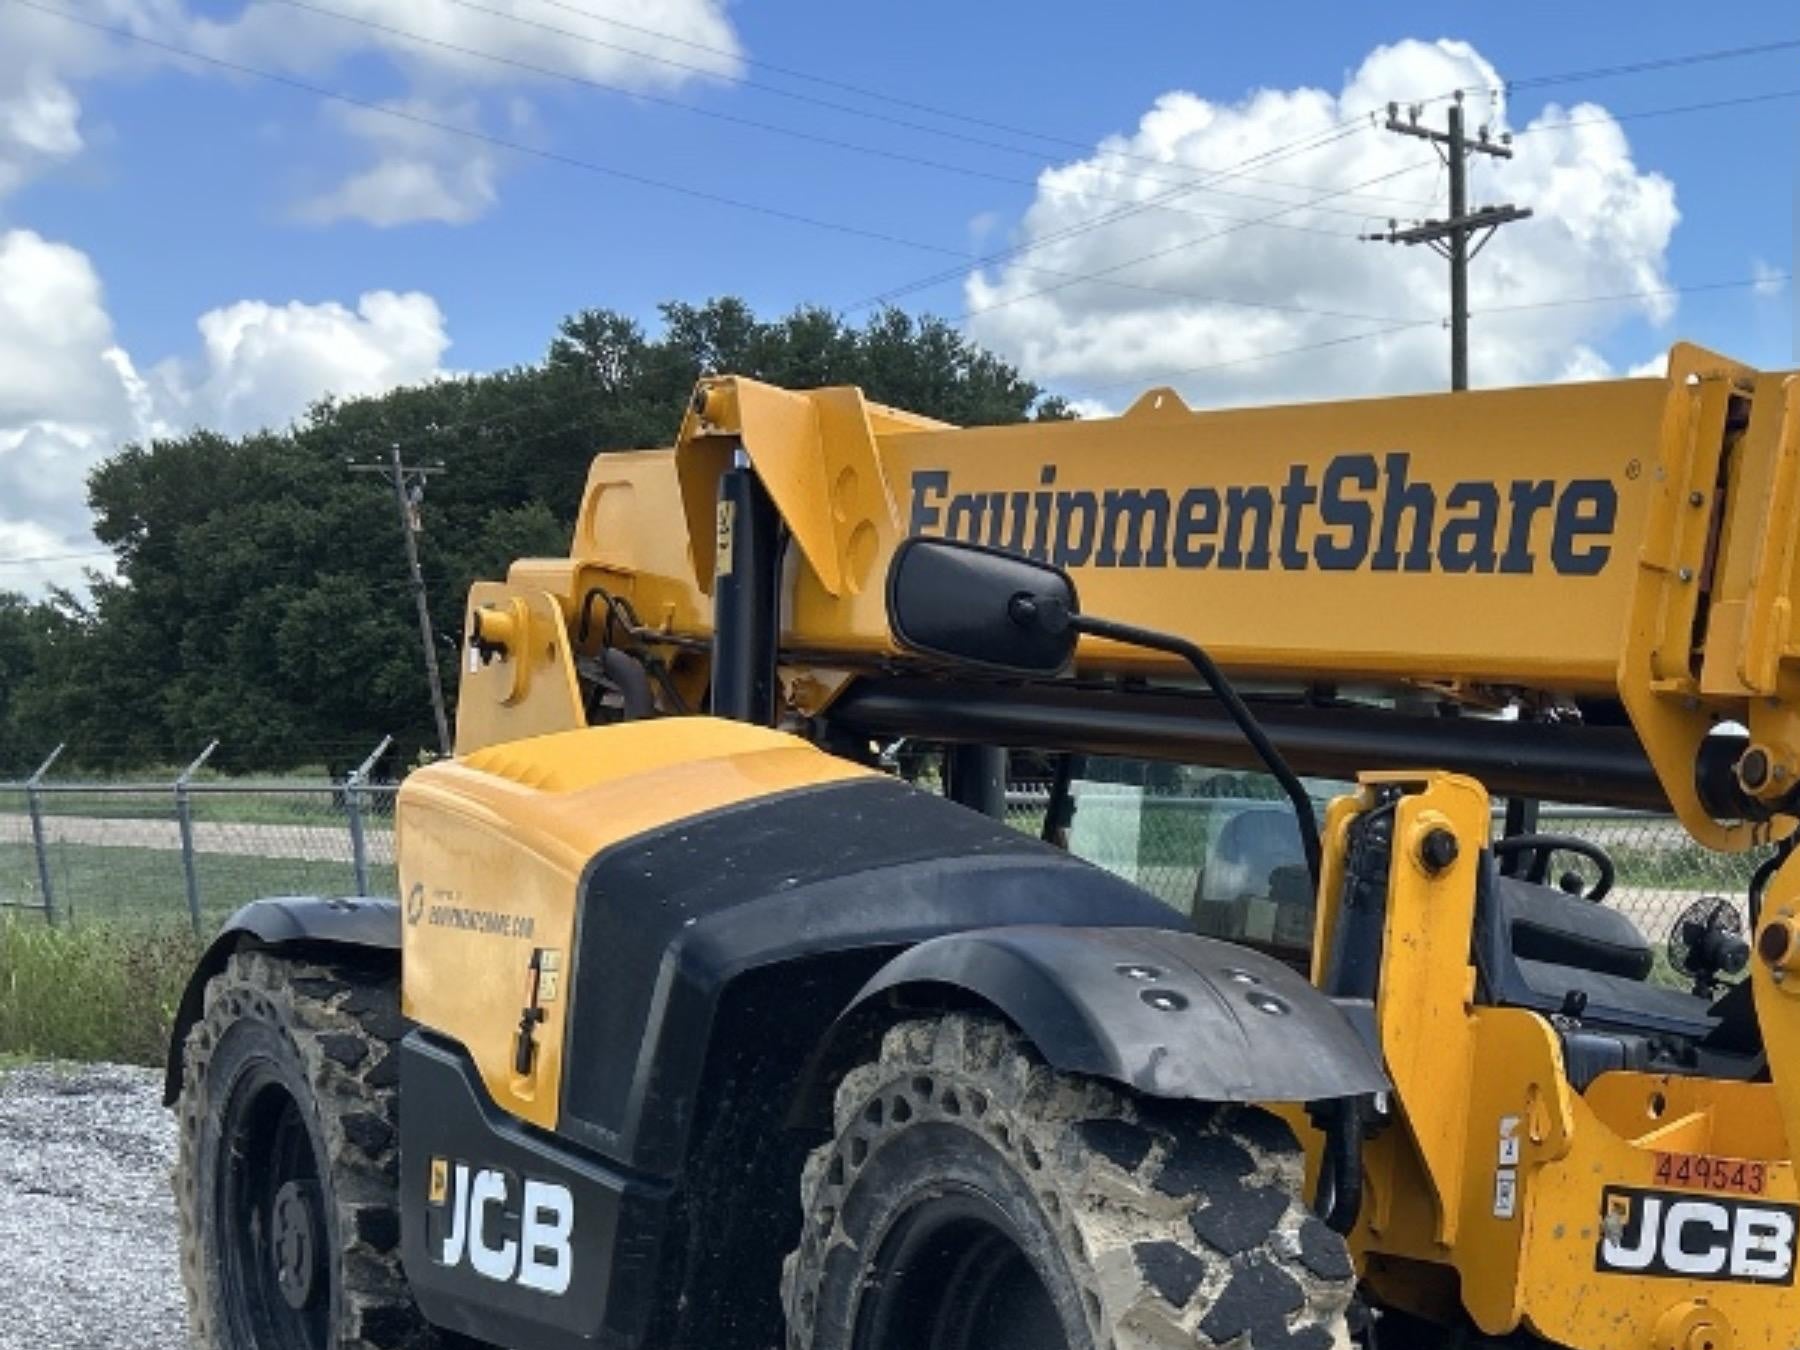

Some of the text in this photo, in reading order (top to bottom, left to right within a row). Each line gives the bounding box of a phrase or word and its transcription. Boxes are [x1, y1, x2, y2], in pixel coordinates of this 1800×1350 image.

[910, 453, 1619, 577] EquipmentShare
[1656, 1153, 1764, 1194] 449543
[443, 1164, 574, 1297] JCB
[1602, 1198, 1795, 1280] JCB
